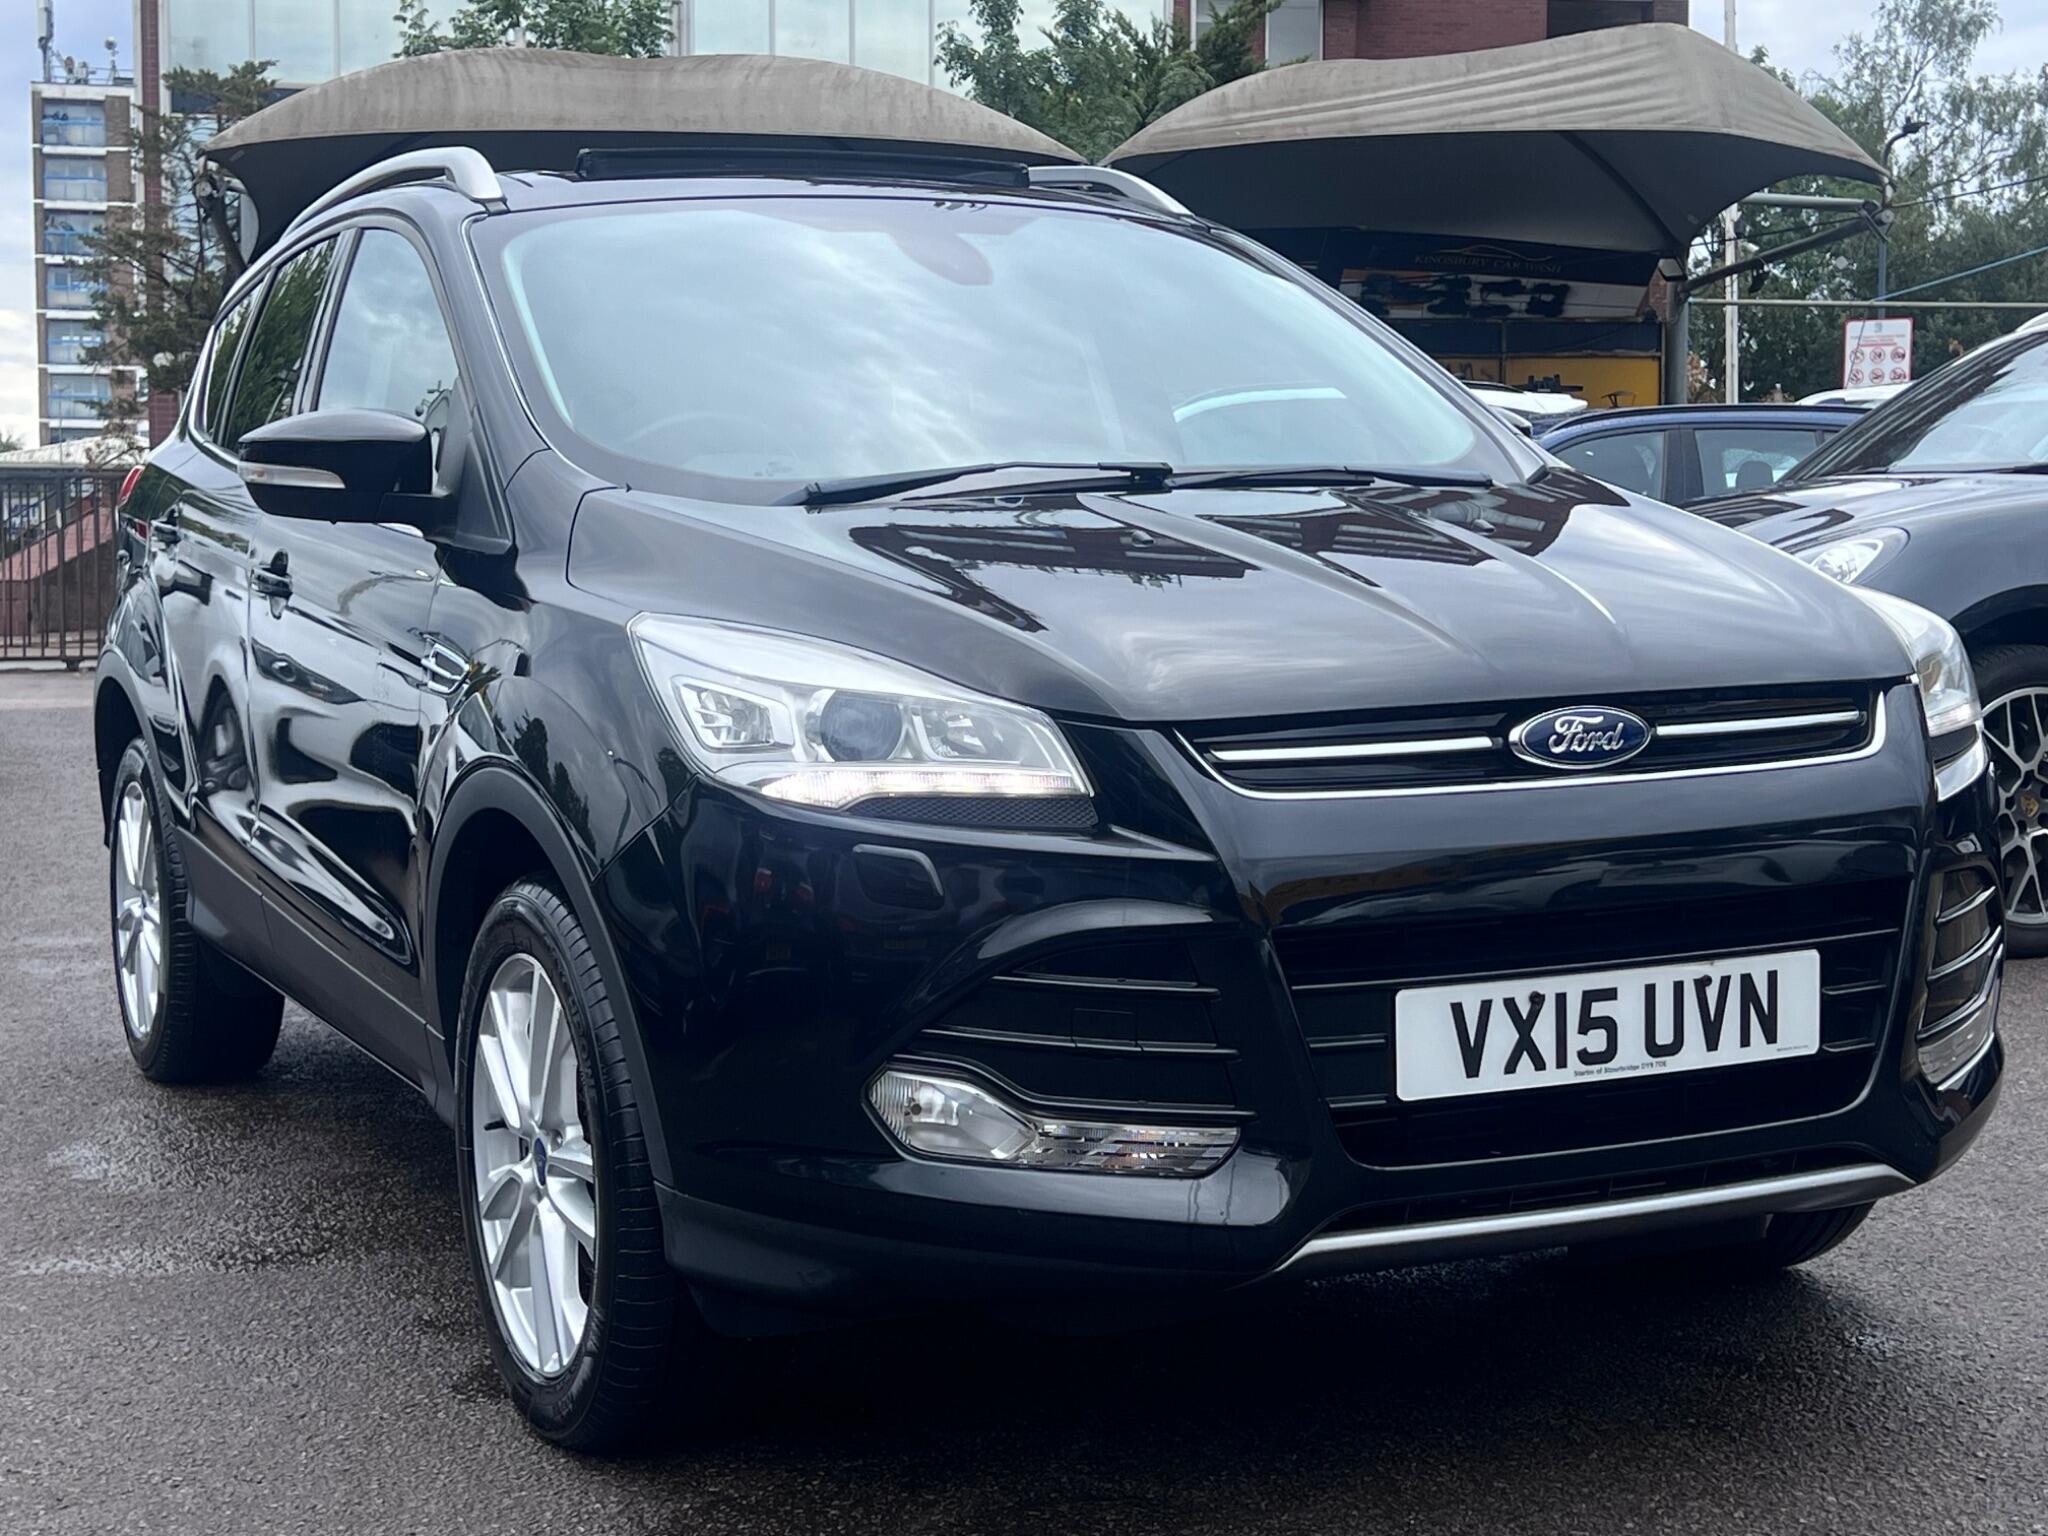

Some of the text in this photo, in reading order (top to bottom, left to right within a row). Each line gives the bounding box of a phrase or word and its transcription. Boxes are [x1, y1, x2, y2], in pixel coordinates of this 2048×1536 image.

[1549, 716, 1625, 753] Ford
[1450, 969, 1779, 1079] VX15 UVN
